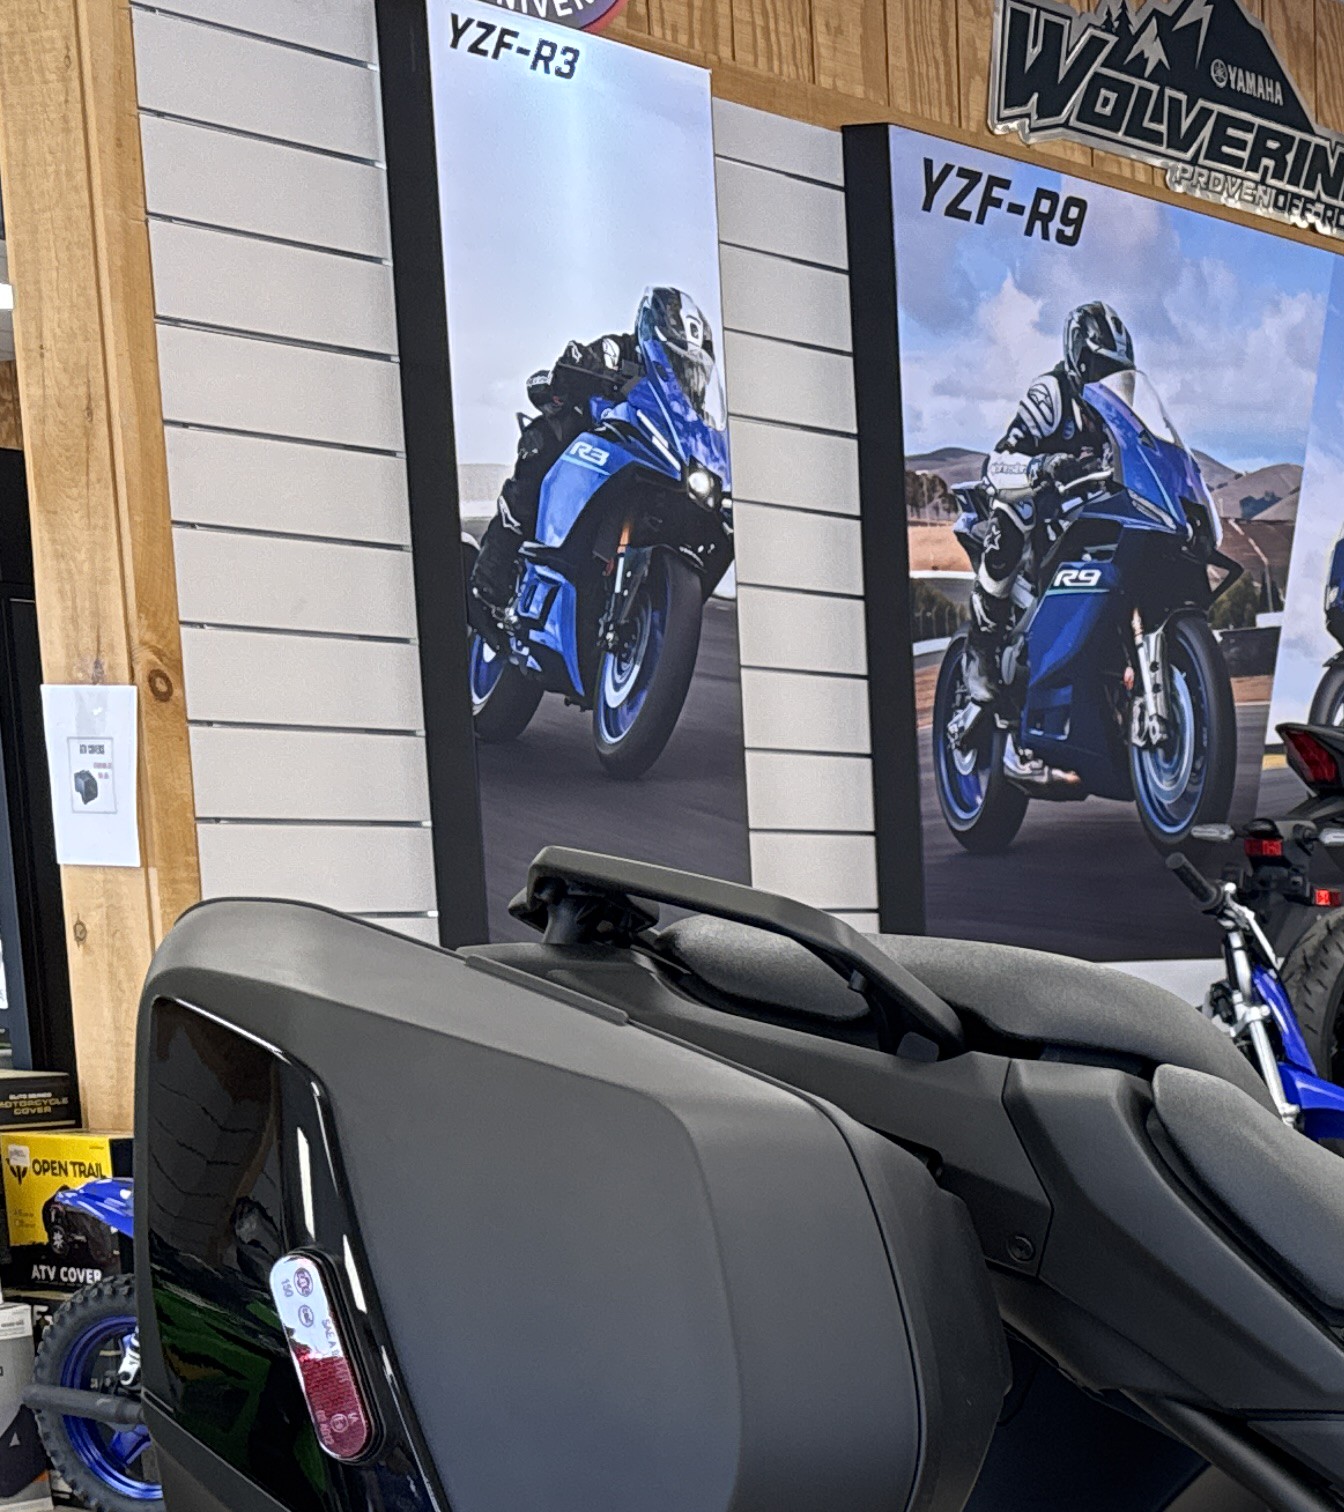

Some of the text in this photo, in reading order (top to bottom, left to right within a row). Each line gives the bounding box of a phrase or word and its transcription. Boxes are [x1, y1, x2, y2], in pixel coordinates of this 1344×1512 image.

[450, 13, 580, 80] YZF-R3
[1227, 64, 1284, 106] YAMAHA
[922, 158, 1088, 247] YZF-R9
[569, 440, 610, 466] R3
[1053, 568, 1101, 587] R9
[13, 1106, 52, 1116] COVER
[32, 1158, 106, 1180] OPEN TRAIL
[31, 1264, 102, 1284] ATV COVER
